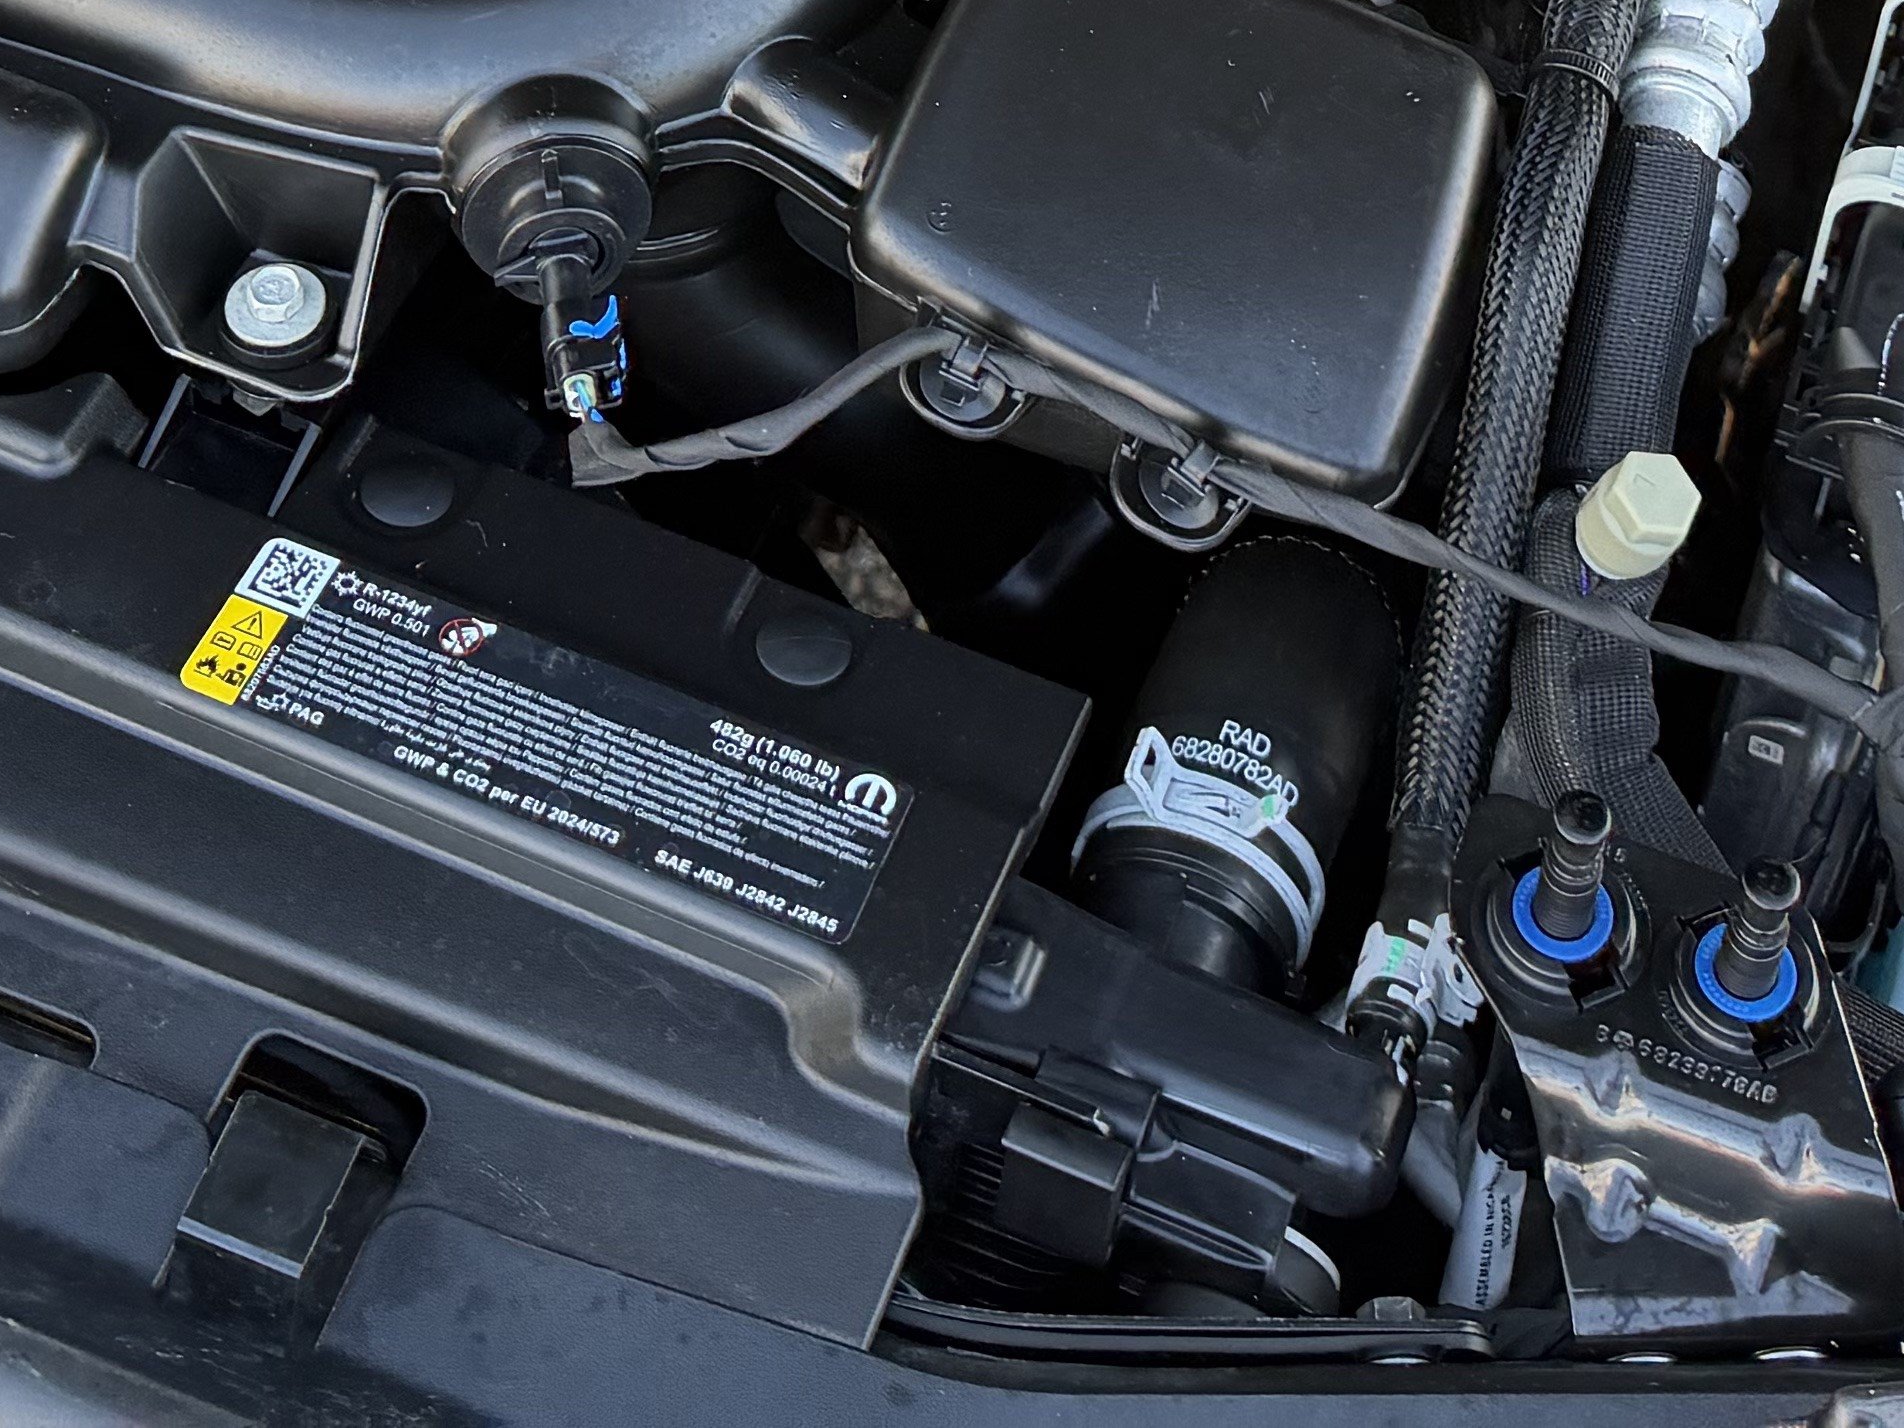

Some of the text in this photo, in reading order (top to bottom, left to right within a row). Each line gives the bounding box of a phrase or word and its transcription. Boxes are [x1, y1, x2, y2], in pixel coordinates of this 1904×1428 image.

[353, 598, 431, 637] GWP 0.501
[364, 582, 432, 617] R-1234yf
[288, 702, 325, 726] PAG
[1219, 719, 1271, 758] RAD
[710, 719, 840, 783] 482g (1.060 lb)
[712, 738, 747, 761] CO2
[747, 754, 767, 773] eq
[769, 760, 827, 792] 0.00024
[1172, 735, 1299, 808] 68280782AD
[393, 745, 620, 845] GWP & CO2 per EU 2024/573
[654, 849, 839, 933] SAE J639 J2842 J2845
